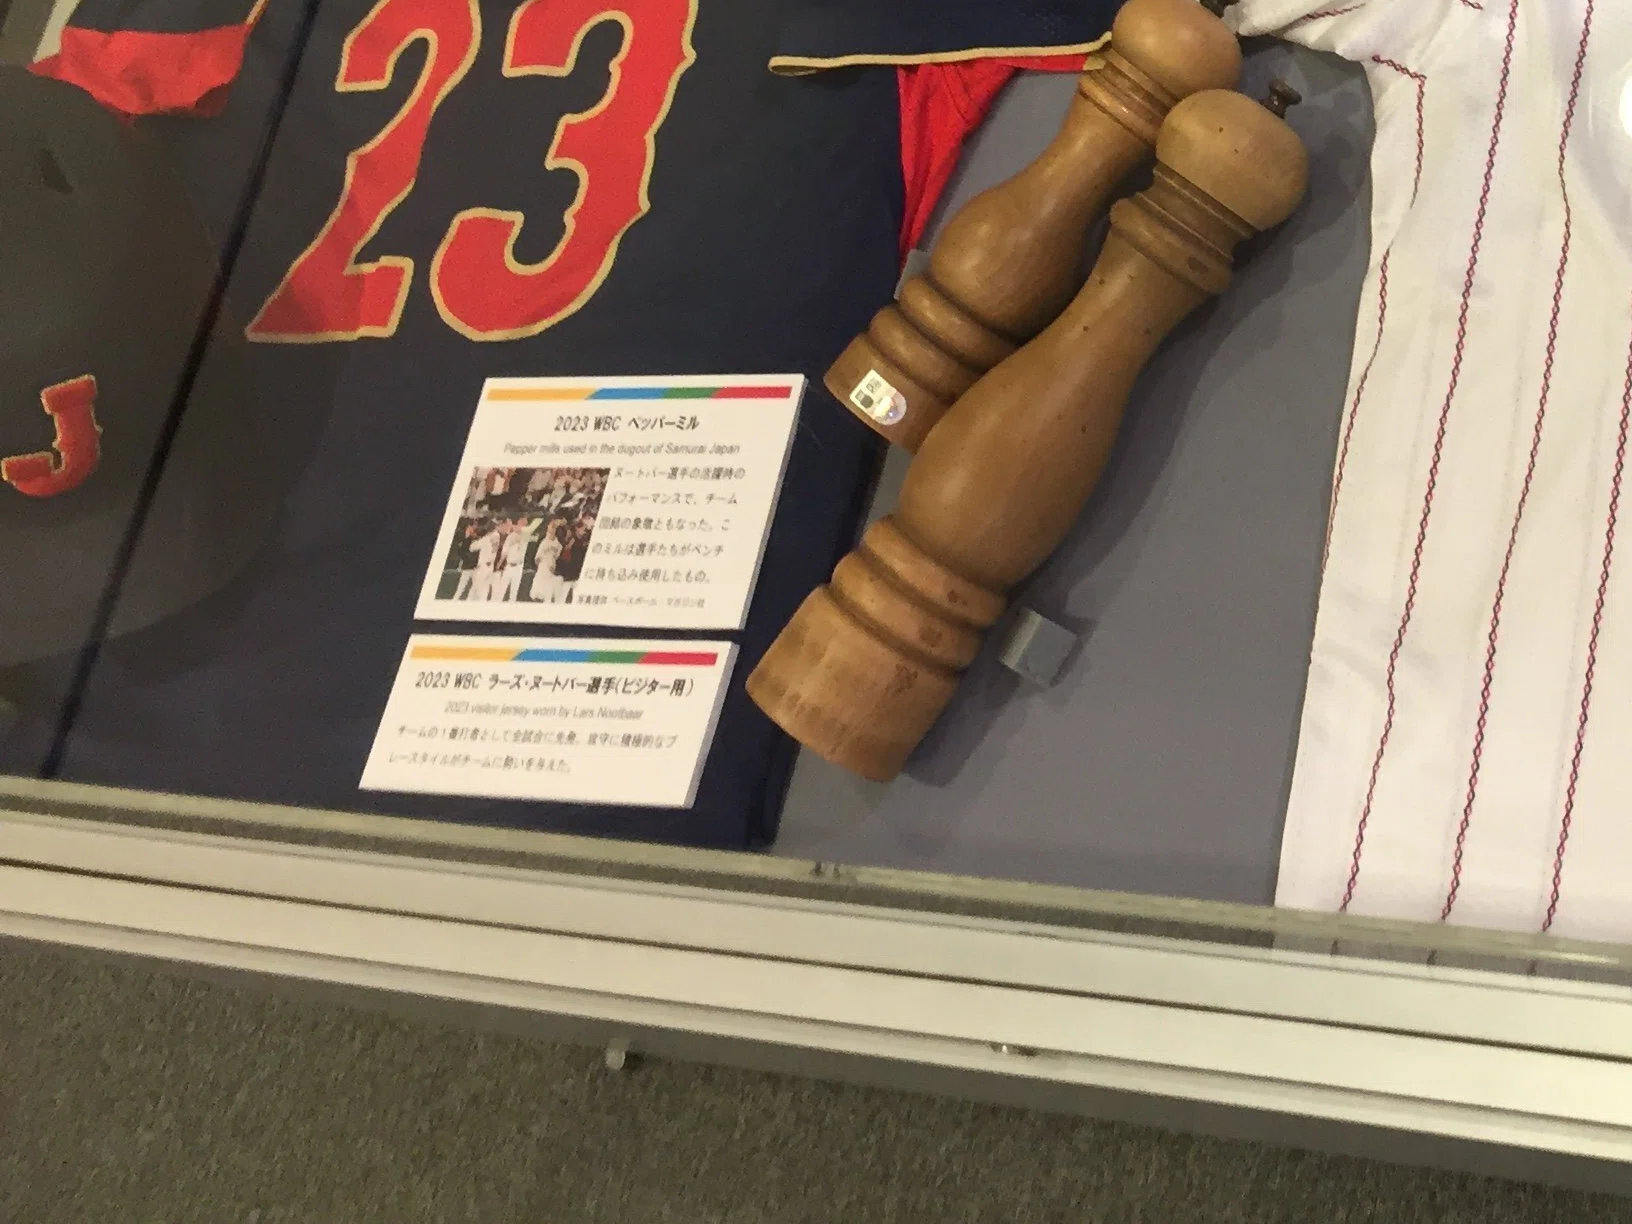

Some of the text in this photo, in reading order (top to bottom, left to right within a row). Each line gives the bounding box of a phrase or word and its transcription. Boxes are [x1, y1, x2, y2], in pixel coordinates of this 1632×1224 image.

[554, 416, 589, 431] 2023
[593, 416, 621, 431] WBC
[1, 374, 103, 498] J
[504, 442, 537, 455] Pepper
[564, 443, 587, 454] used
[590, 444, 598, 454] in
[601, 443, 614, 454] the
[653, 443, 664, 454] of
[666, 443, 706, 454] Samurai
[709, 443, 741, 456] Japan
[415, 671, 451, 689] 2023
[454, 673, 482, 690] WBC
[558, 706, 570, 718] by
